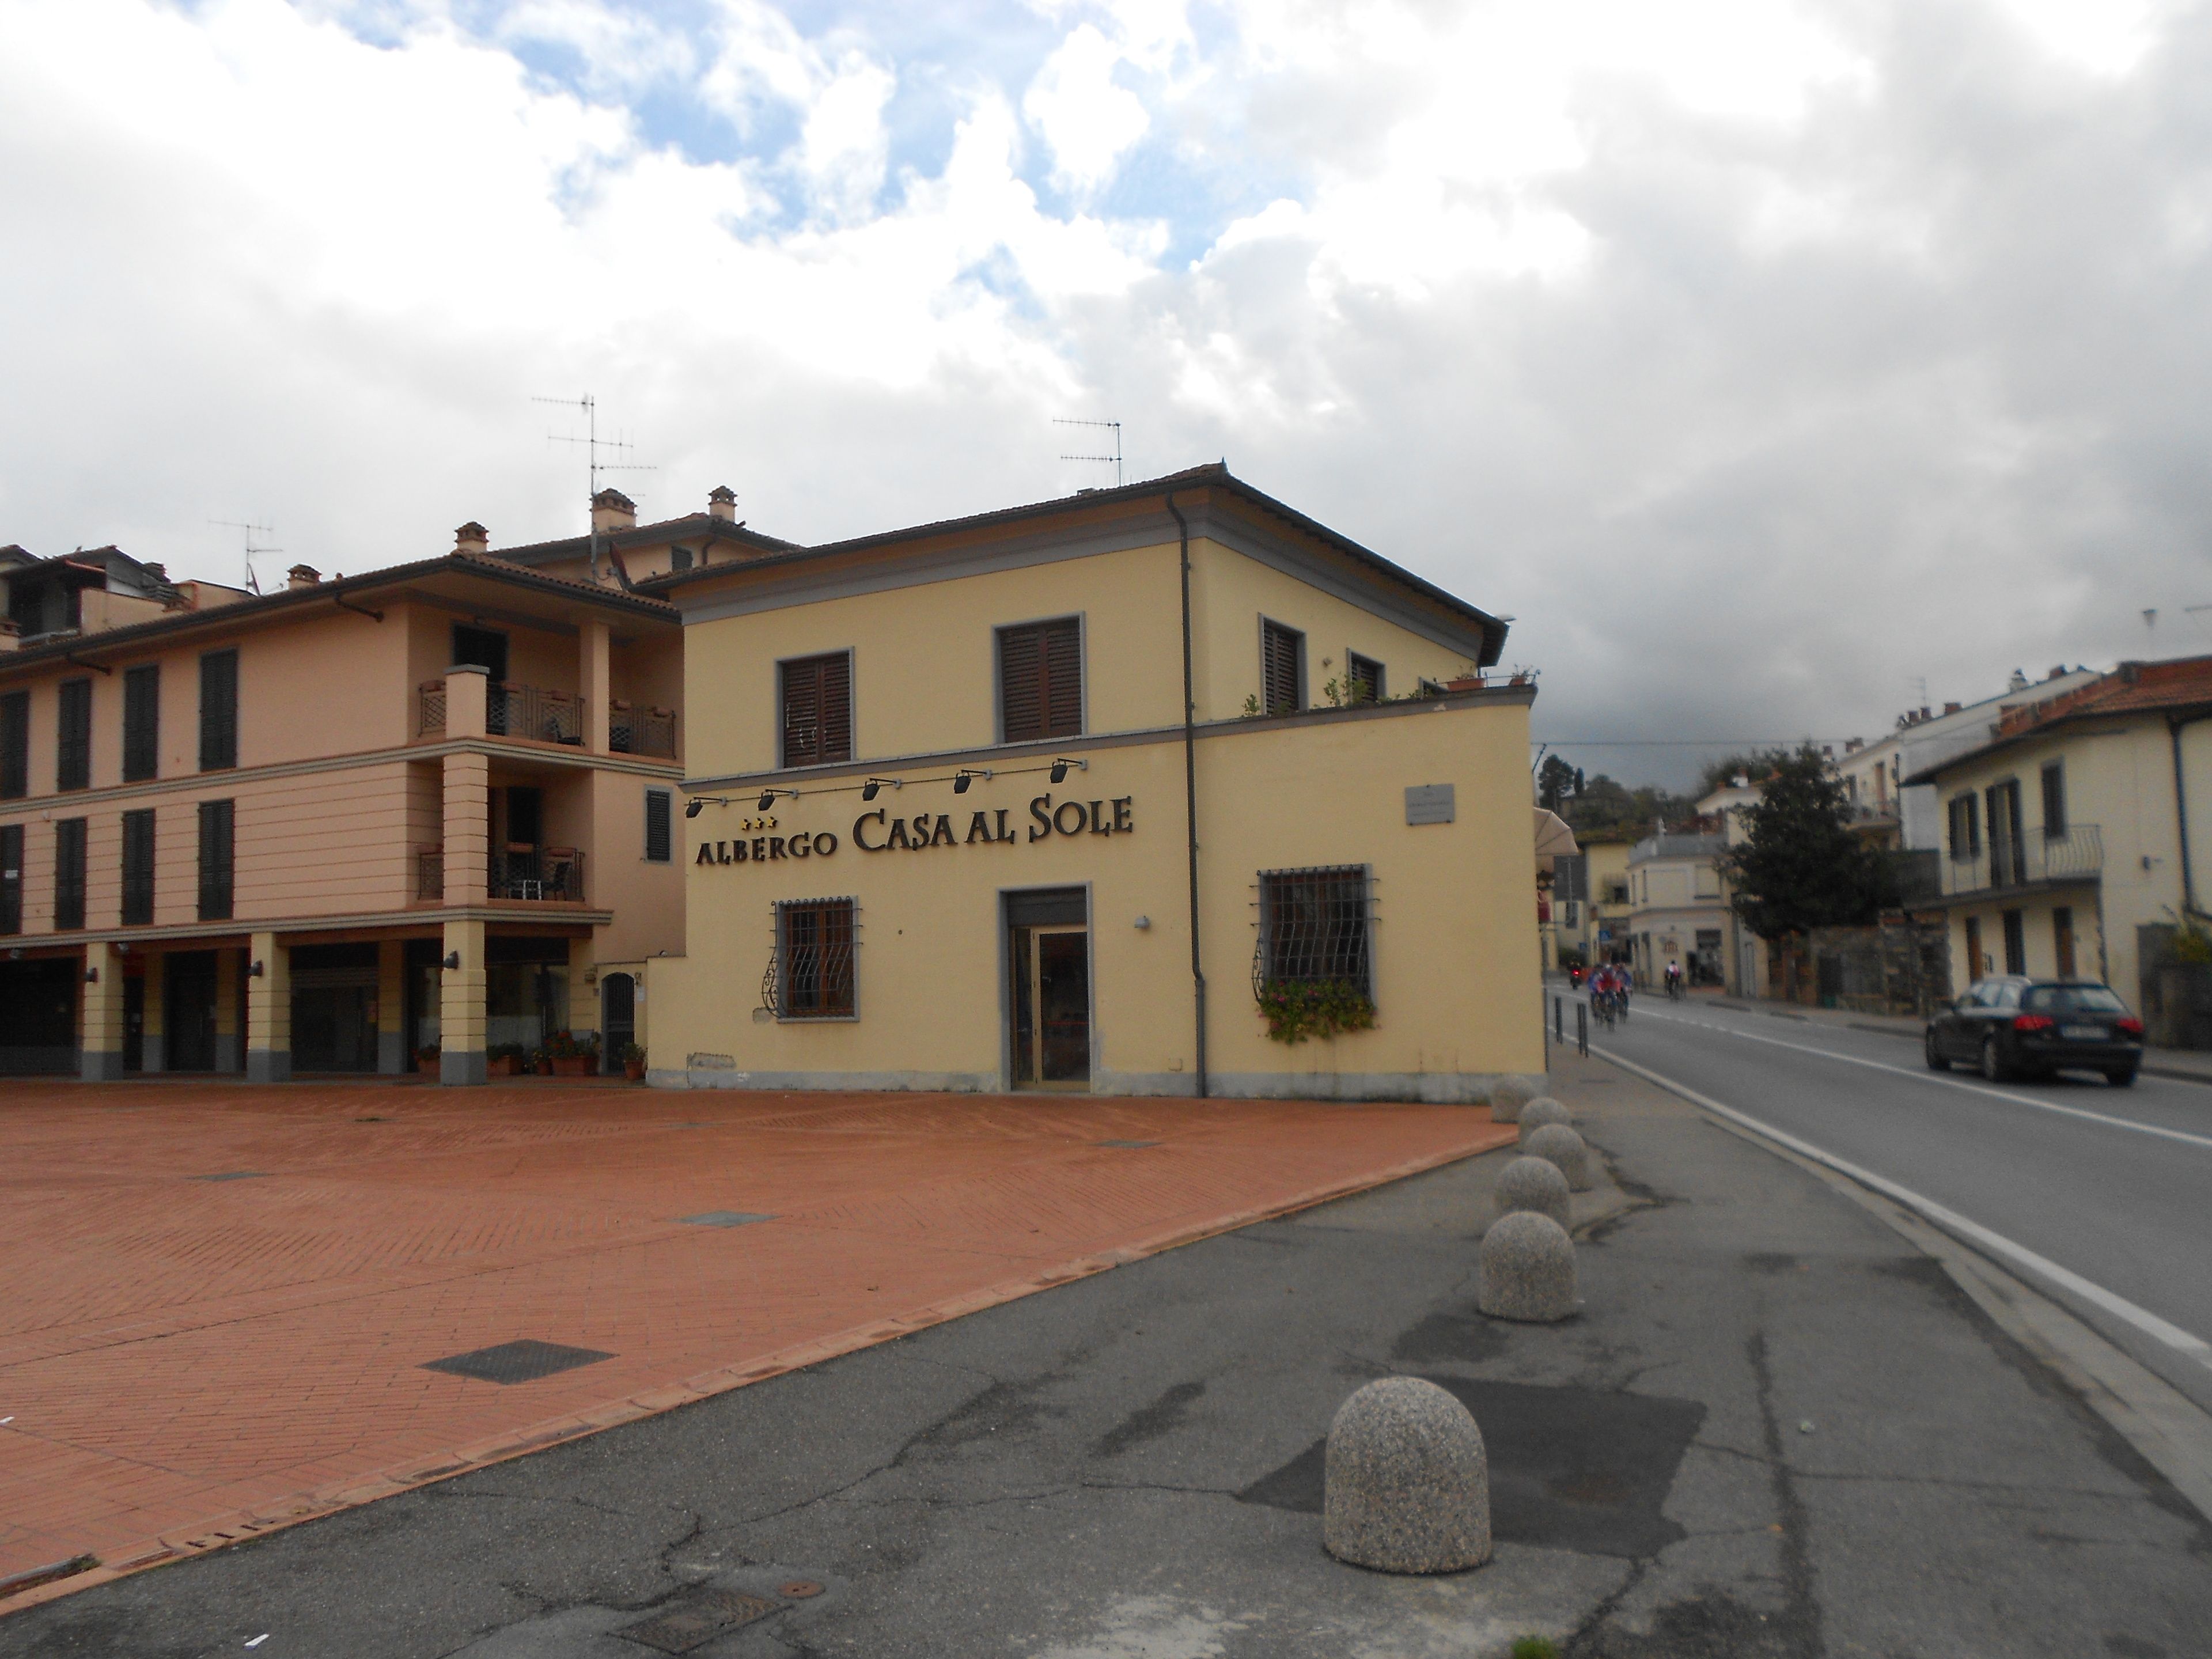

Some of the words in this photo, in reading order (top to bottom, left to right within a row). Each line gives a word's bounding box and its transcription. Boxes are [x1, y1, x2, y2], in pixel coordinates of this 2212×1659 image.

[695, 831, 838, 866] ALBERGO
[852, 808, 957, 851] CASA
[963, 808, 1016, 845] AL
[1028, 792, 1134, 843] SOLE
